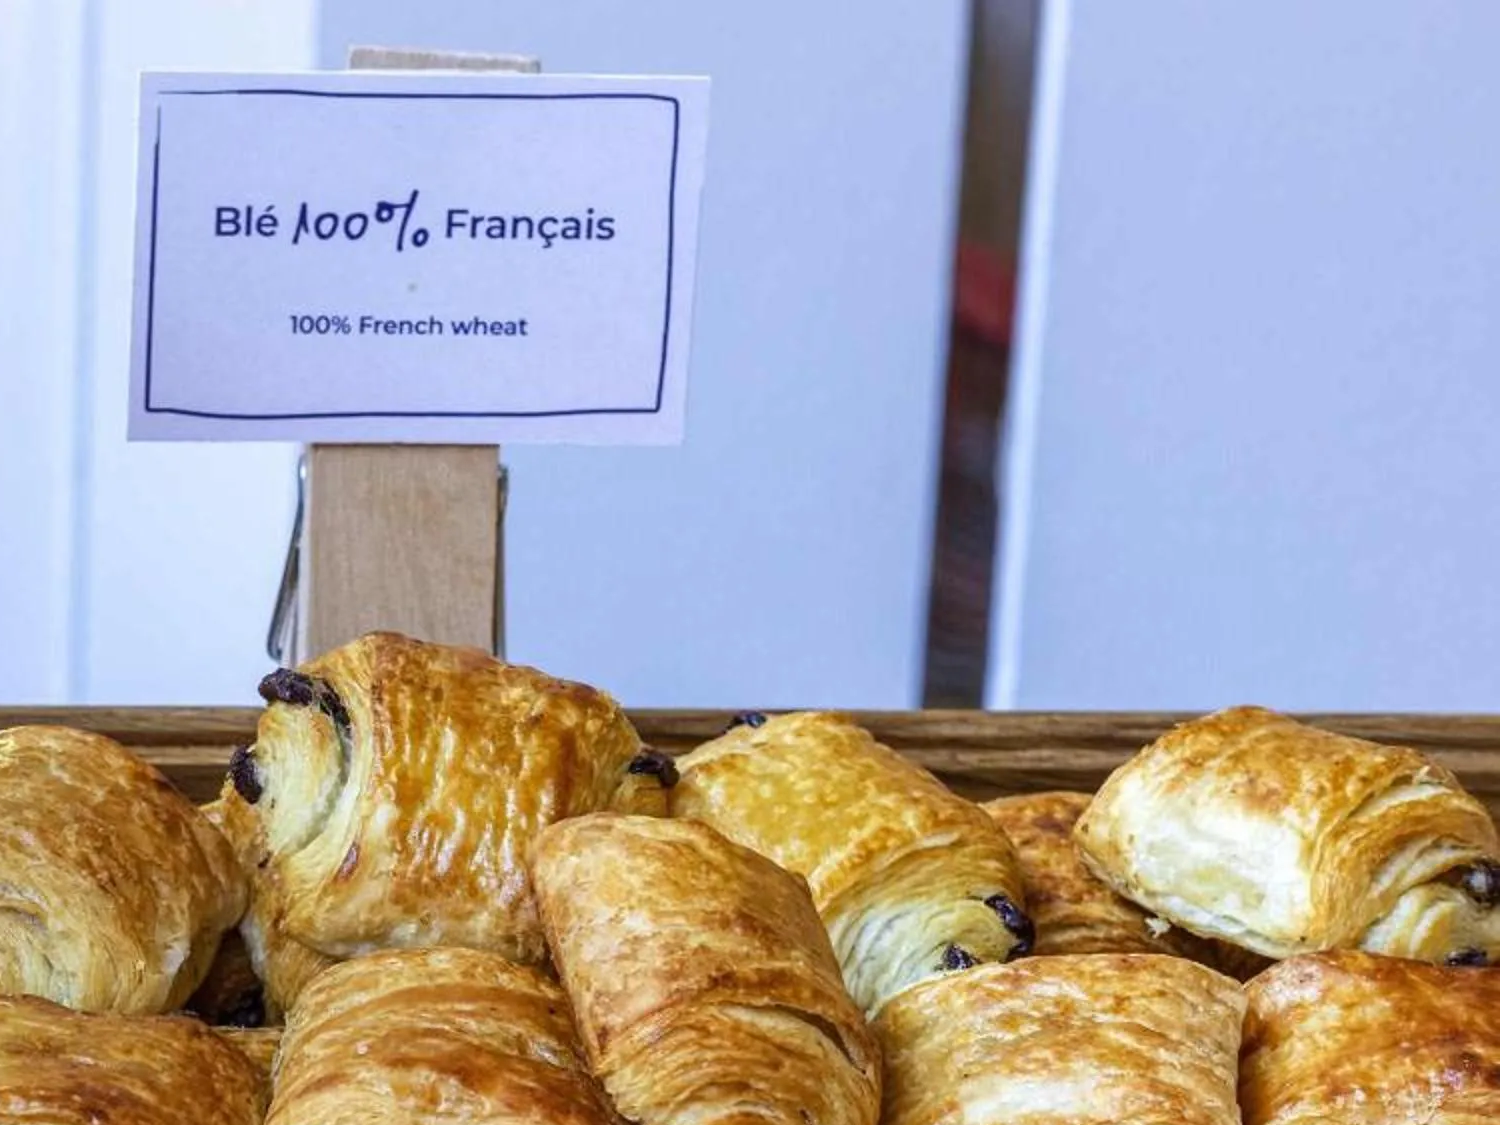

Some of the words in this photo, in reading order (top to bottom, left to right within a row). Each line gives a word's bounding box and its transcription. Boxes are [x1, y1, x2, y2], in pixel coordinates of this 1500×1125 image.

[214, 204, 280, 238] Blé
[291, 189, 431, 252] 100%
[445, 207, 616, 249] Français
[289, 315, 351, 335] 100%
[359, 315, 443, 335] French
[451, 317, 528, 336] wheat
